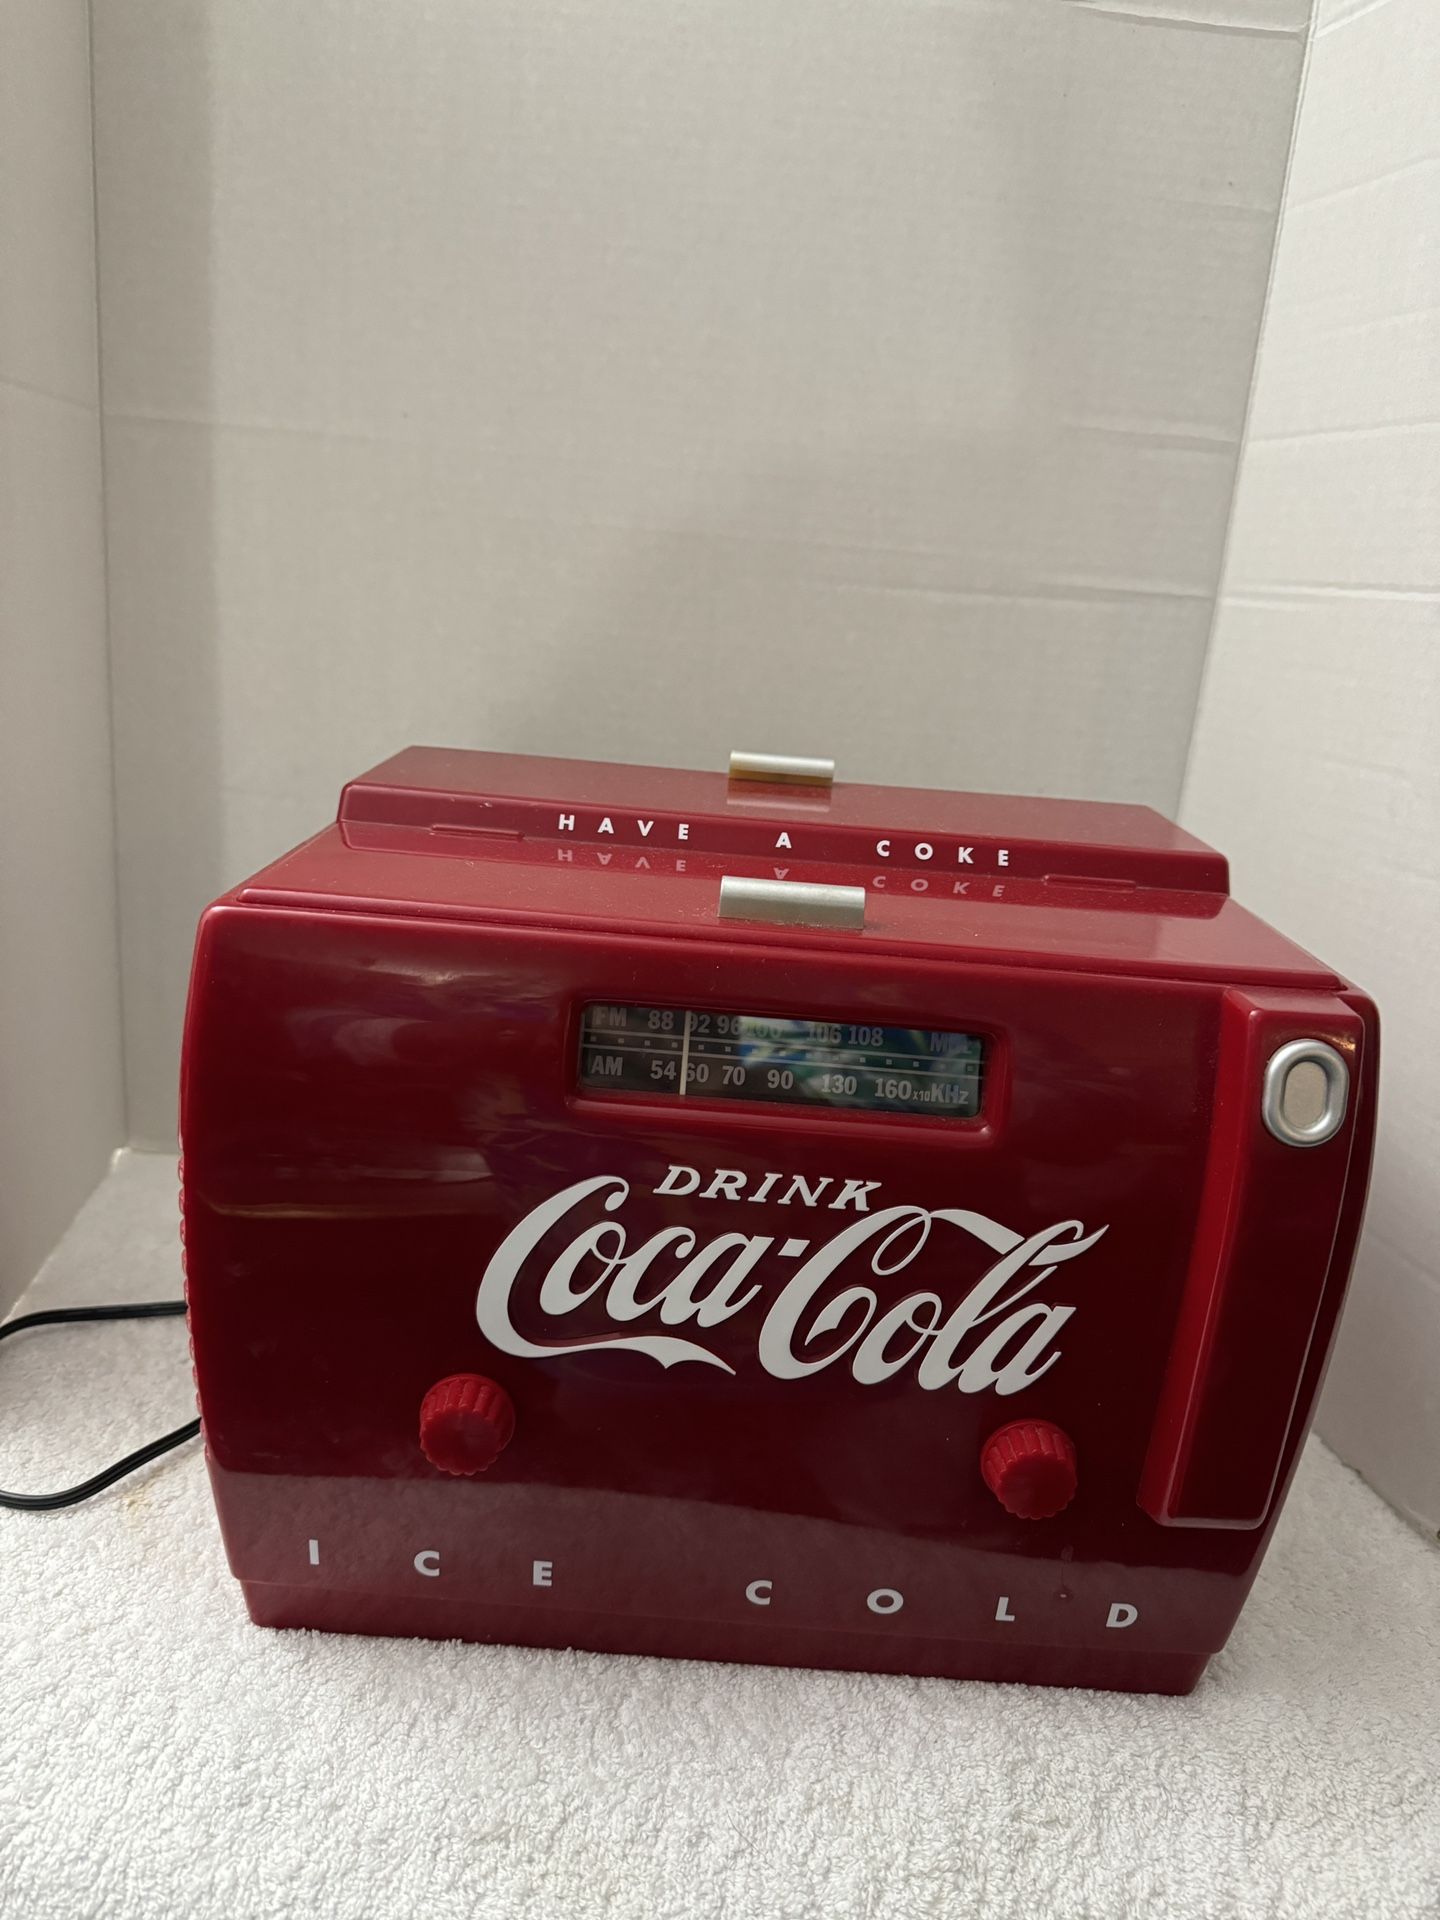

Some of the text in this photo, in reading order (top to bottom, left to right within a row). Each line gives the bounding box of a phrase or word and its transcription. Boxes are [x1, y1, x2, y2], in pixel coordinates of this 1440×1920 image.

[558, 814, 1010, 867] HAVE A COKE
[590, 1007, 628, 1027] FM
[647, 1010, 674, 1030] 88
[717, 1014, 743, 1036] 96
[806, 1024, 842, 1045] 106
[848, 1027, 884, 1047] 108
[590, 1055, 624, 1076] AM
[650, 1060, 677, 1081] 54
[685, 1063, 710, 1083] 60
[722, 1065, 747, 1086] 70
[767, 1070, 794, 1090] 90
[821, 1074, 858, 1096] 130
[652, 1165, 882, 1212] DRINK
[476, 1175, 1110, 1396] Coca-Cola
[309, 1540, 1138, 1627] ICE COLD
